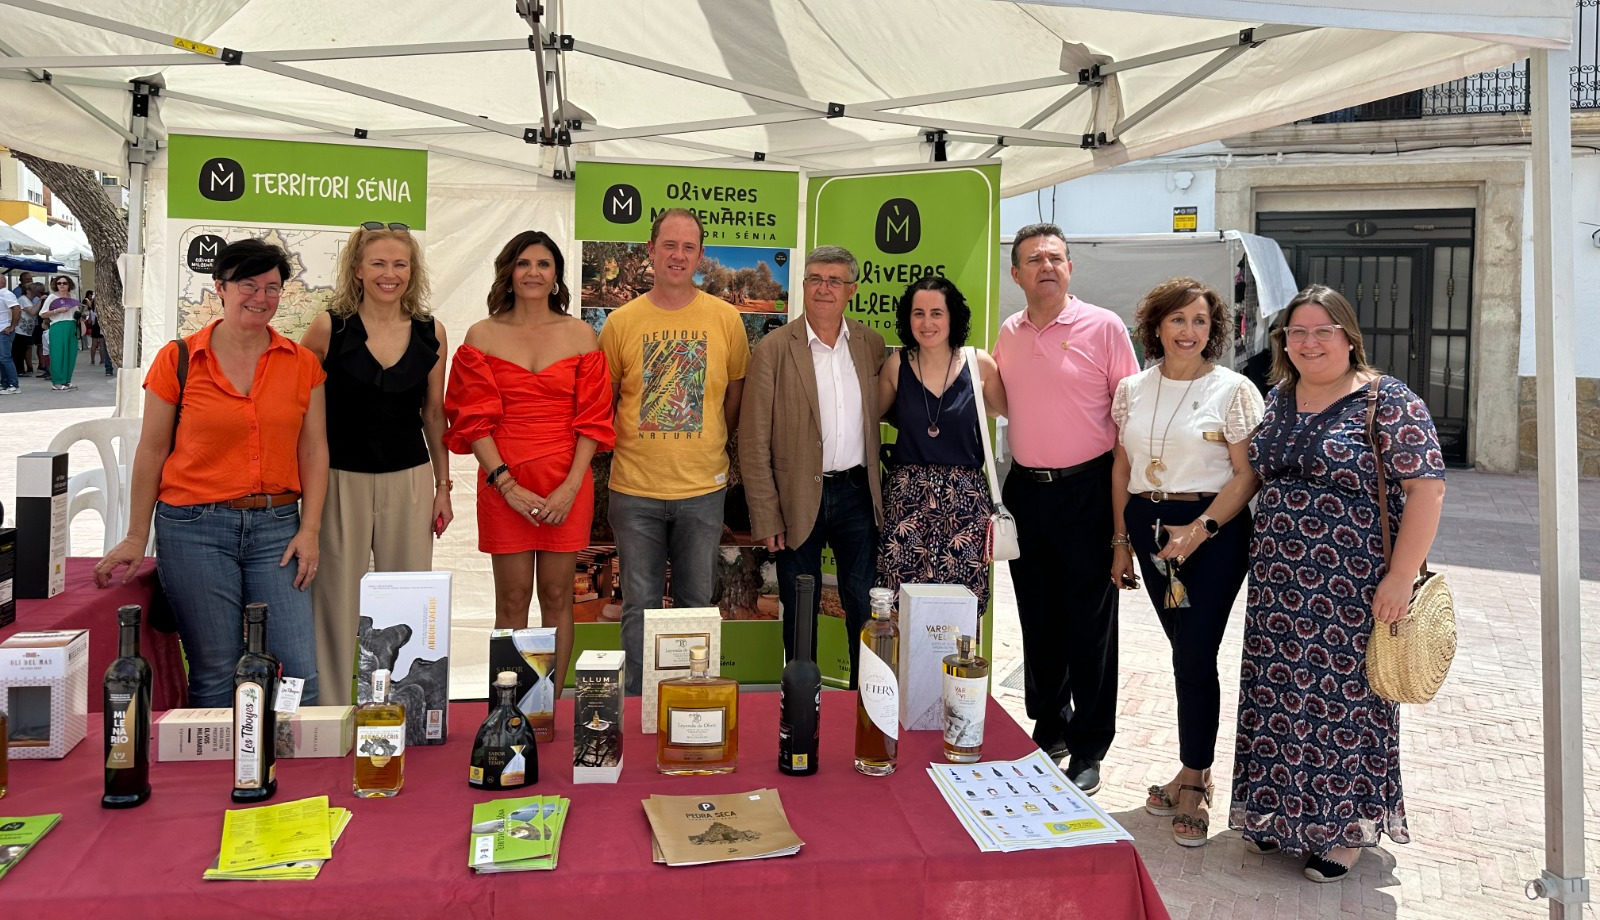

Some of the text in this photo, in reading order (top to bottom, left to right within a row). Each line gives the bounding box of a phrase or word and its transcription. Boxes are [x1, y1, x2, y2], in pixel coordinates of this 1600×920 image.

[252, 173, 412, 203] TERRITORI SÉNIA
[1355, 222, 1367, 234] 11
[735, 230, 776, 241] SÉNIA
[642, 329, 708, 343] DEVIOUS
[113, 710, 126, 719] MI
[113, 719, 126, 727] LE
[112, 727, 127, 735] NA
[110, 735, 129, 744] RIO
